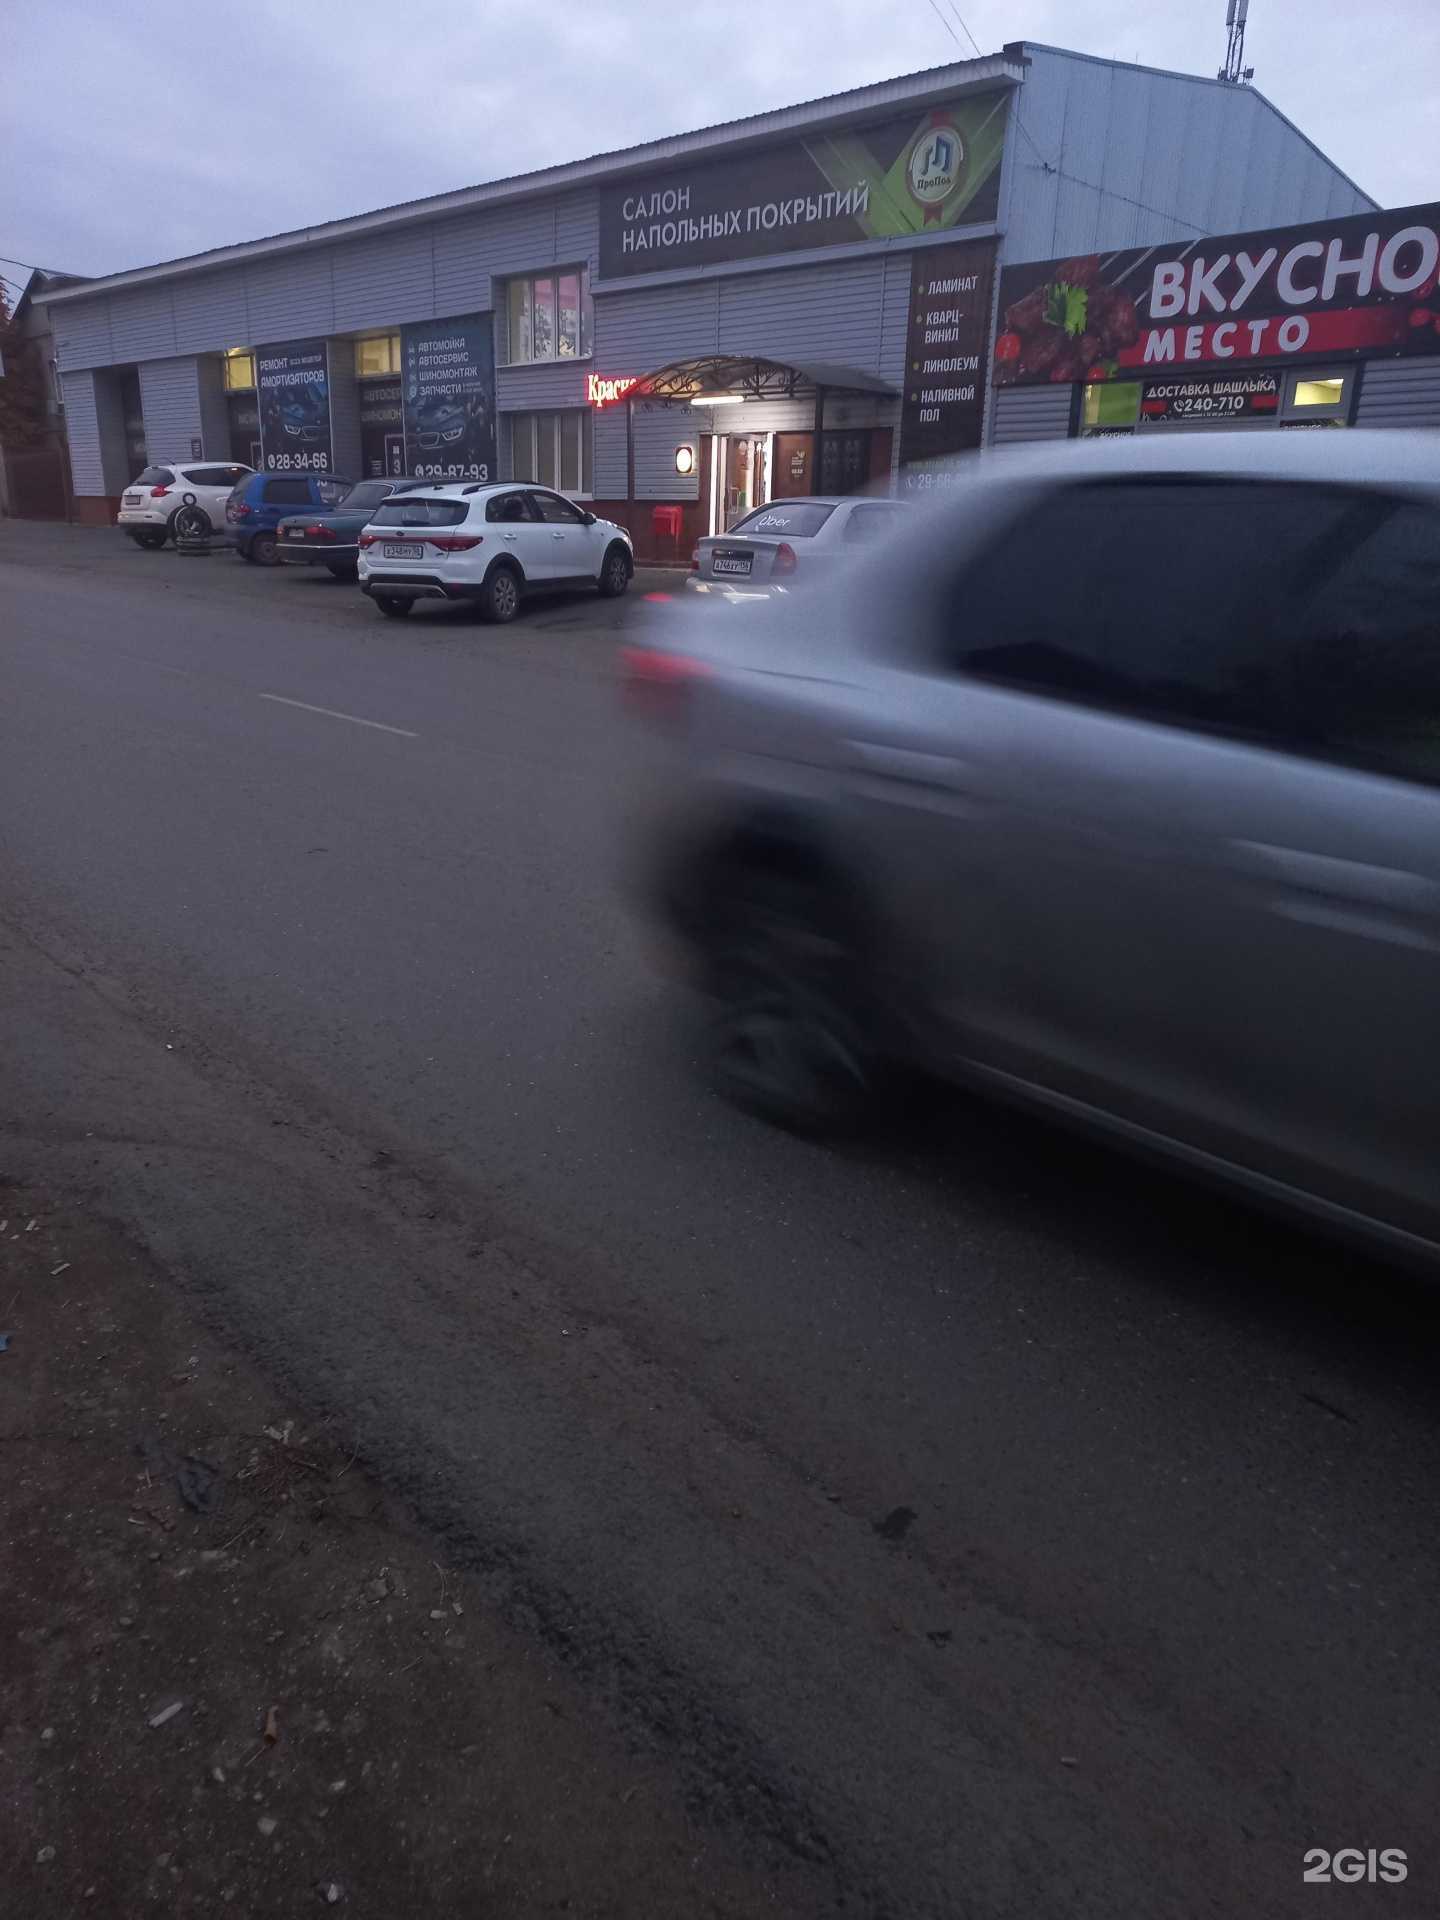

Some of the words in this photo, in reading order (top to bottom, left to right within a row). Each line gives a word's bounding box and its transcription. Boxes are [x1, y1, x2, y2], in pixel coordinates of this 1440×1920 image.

[622, 186, 690, 221] САЛОН
[622, 208, 742, 253] НАПОЛЬНЫХ
[746, 179, 870, 233] ПОКРЫТИЙ
[1149, 225, 1440, 319] ВКУСНО
[928, 275, 979, 295] ЛАМИНАТ
[926, 309, 964, 326] КВАРЦ-
[924, 327, 959, 344] ВИНИЛ
[1143, 315, 1310, 362] МЕСТО
[418, 337, 465, 353] АВТОМОЙКА
[260, 357, 288, 371] РЕМОНТ
[418, 352, 469, 366] АВТОСЕРВИС
[922, 356, 979, 374] ЛИНОЛЕУМ
[260, 370, 325, 388] АМОРТИЗАТОРОВ
[419, 366, 479, 381] ШИНОМОНТАЖ
[419, 383, 462, 397] ЗАПЧАСТИ
[921, 384, 975, 404] НАЛИВНОЙ
[1147, 383, 1210, 398] ДОСТАВКА
[1213, 379, 1277, 395] ШАШЛЫКА
[1184, 395, 1245, 412] 240-710
[919, 408, 940, 423] ПОЛ
[276, 452, 328, 470] 28-34-66
[425, 463, 489, 482] 29-87-93
